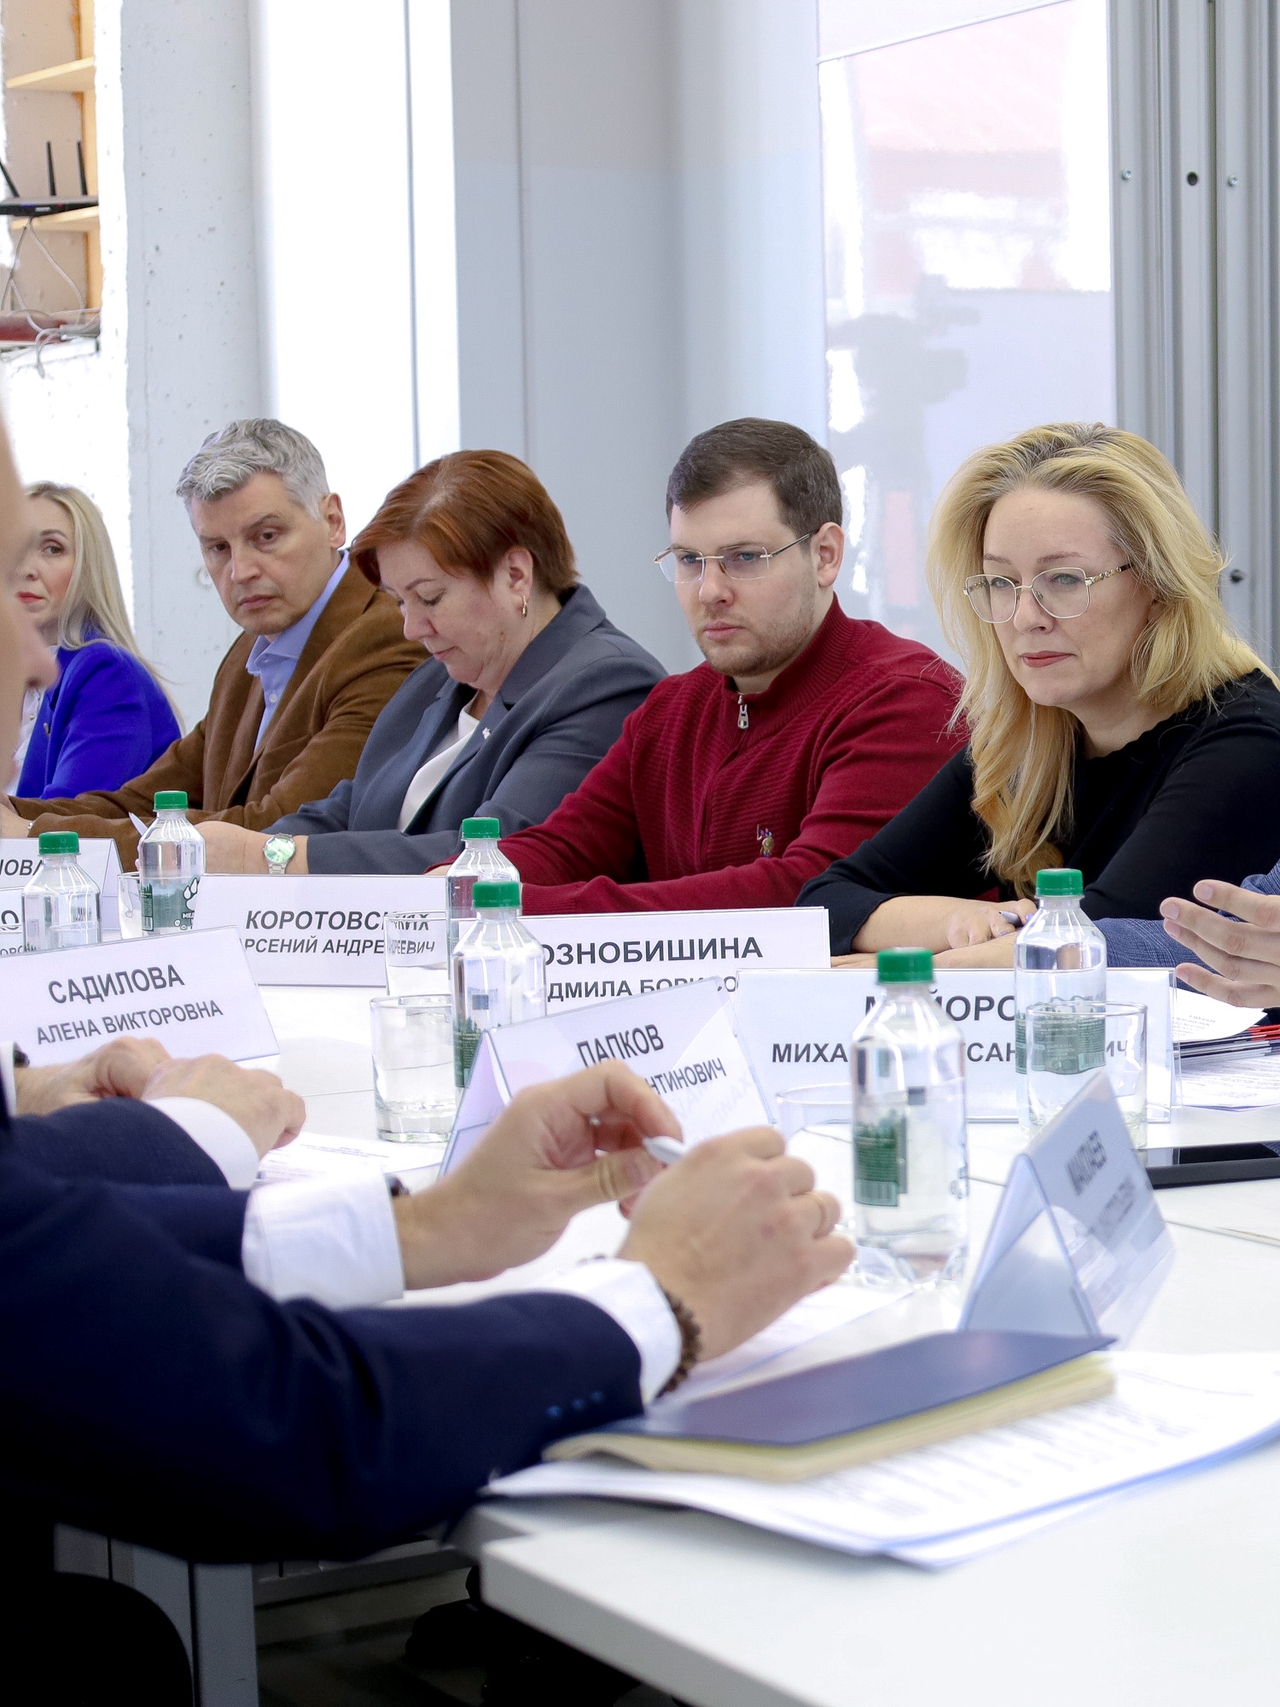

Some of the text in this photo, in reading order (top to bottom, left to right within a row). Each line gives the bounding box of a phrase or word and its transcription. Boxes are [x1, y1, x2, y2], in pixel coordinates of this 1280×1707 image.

[240, 934, 318, 954] РСЕНИЙ
[48, 964, 186, 1005] САДИЛОВА
[36, 999, 224, 1046] АЛЕНА ВИКТОРОВНА
[576, 1023, 665, 1068] ПАПКОВ
[772, 1043, 849, 1063] МИХА
